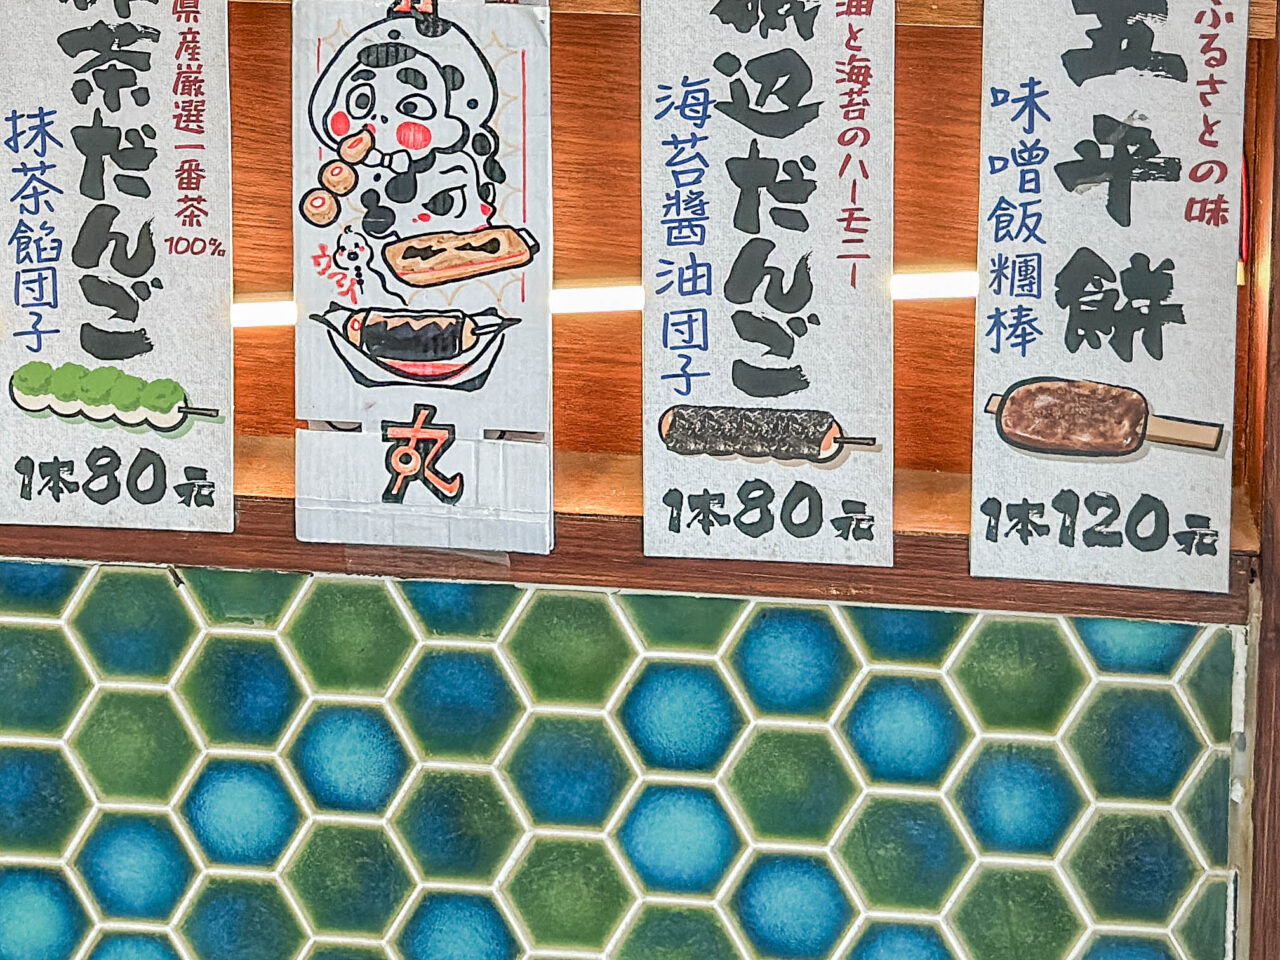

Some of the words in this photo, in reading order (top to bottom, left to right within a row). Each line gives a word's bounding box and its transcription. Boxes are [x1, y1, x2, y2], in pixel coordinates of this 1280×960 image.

[3, 106, 64, 353] 抹茶餡団子
[164, 235, 226, 258] 100%
[985, 76, 1051, 358] 味噌飯糰棒
[14, 445, 216, 508] 1本80元
[662, 478, 875, 542] 1本80元
[980, 488, 1219, 557] 1本120元
